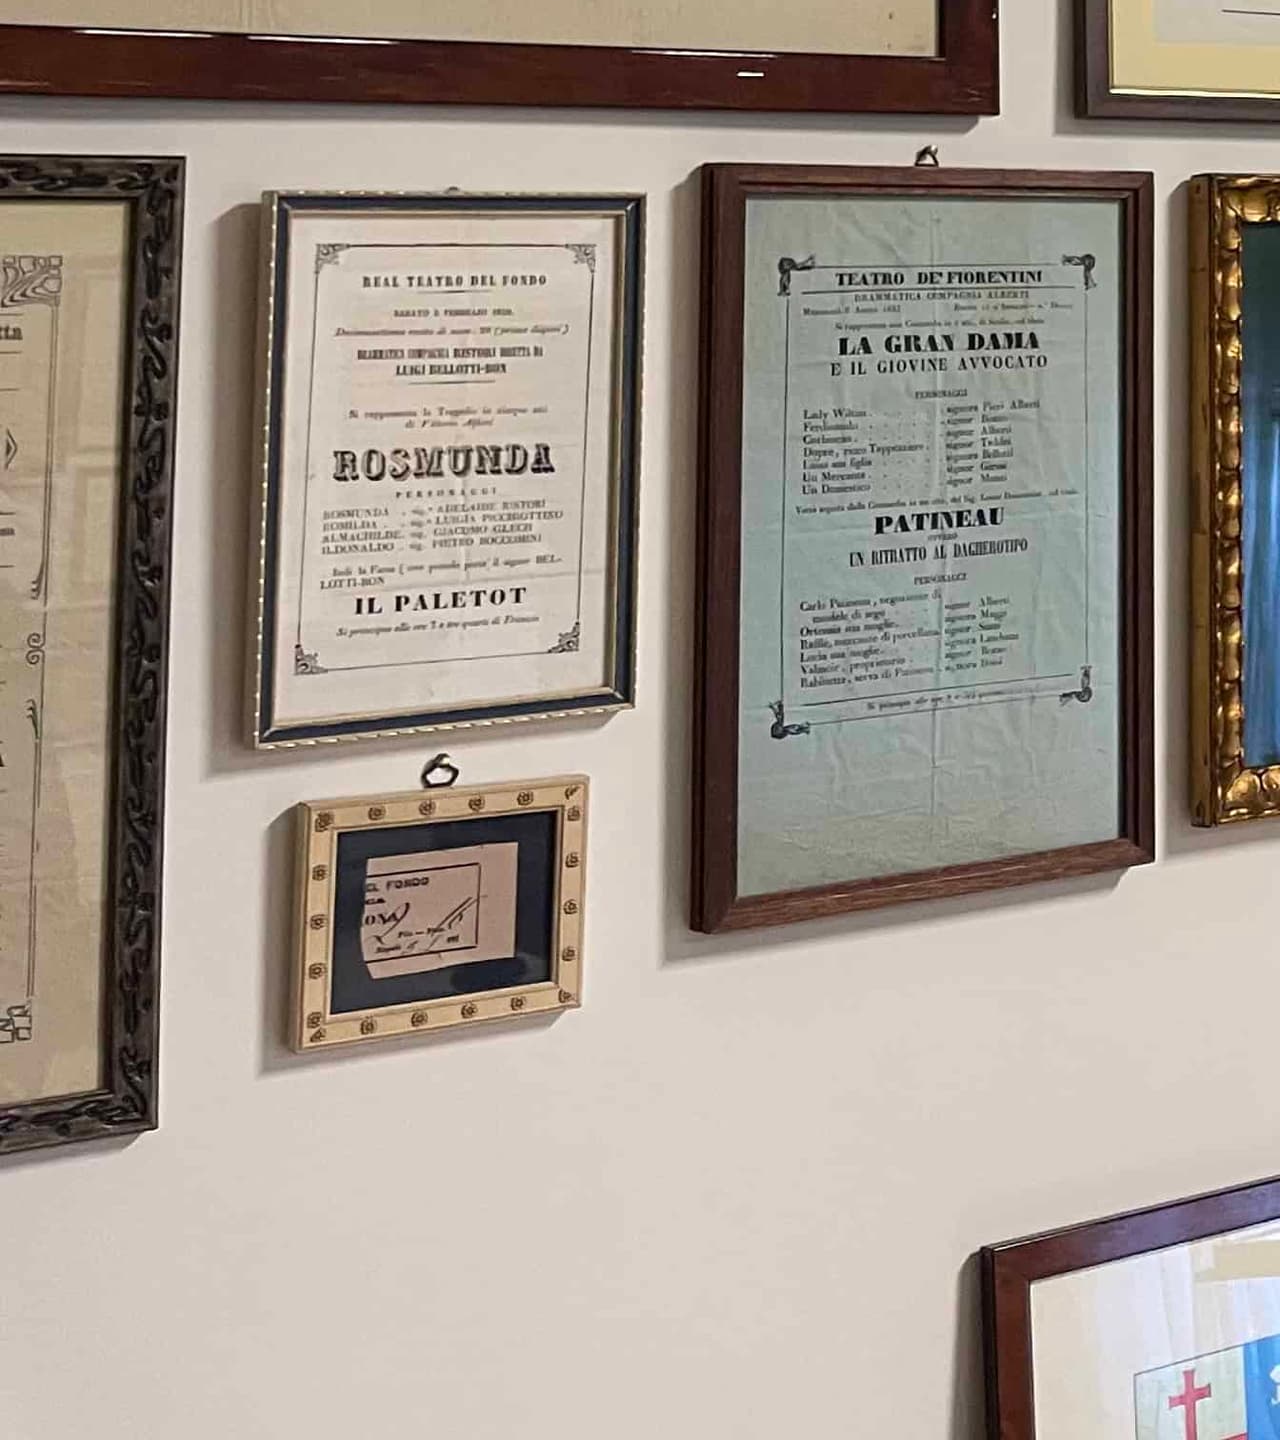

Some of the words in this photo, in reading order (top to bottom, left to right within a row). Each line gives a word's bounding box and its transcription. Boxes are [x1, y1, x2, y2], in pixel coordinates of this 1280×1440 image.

[363, 276, 399, 287] REAL
[407, 276, 463, 287] TEATRO
[471, 276, 496, 286] DEL
[503, 275, 547, 286] FONDO
[836, 272, 904, 287] TEATRO
[947, 271, 1042, 284] FIORENTINI
[839, 337, 872, 355] LA
[884, 334, 954, 353] GRAN
[968, 332, 1040, 351] DAMA
[396, 365, 425, 376] LUIGI
[831, 363, 840, 376] E
[851, 362, 866, 375] IL
[877, 358, 947, 374] GIOVINE
[958, 355, 1047, 371] AVVOCATO
[333, 443, 555, 481] ROSMUNDA
[874, 508, 1004, 534] PATINEAU
[872, 547, 926, 564] RITRATTO
[933, 545, 947, 558] AL
[355, 598, 382, 615] IL
[395, 587, 526, 612] PALETOT
